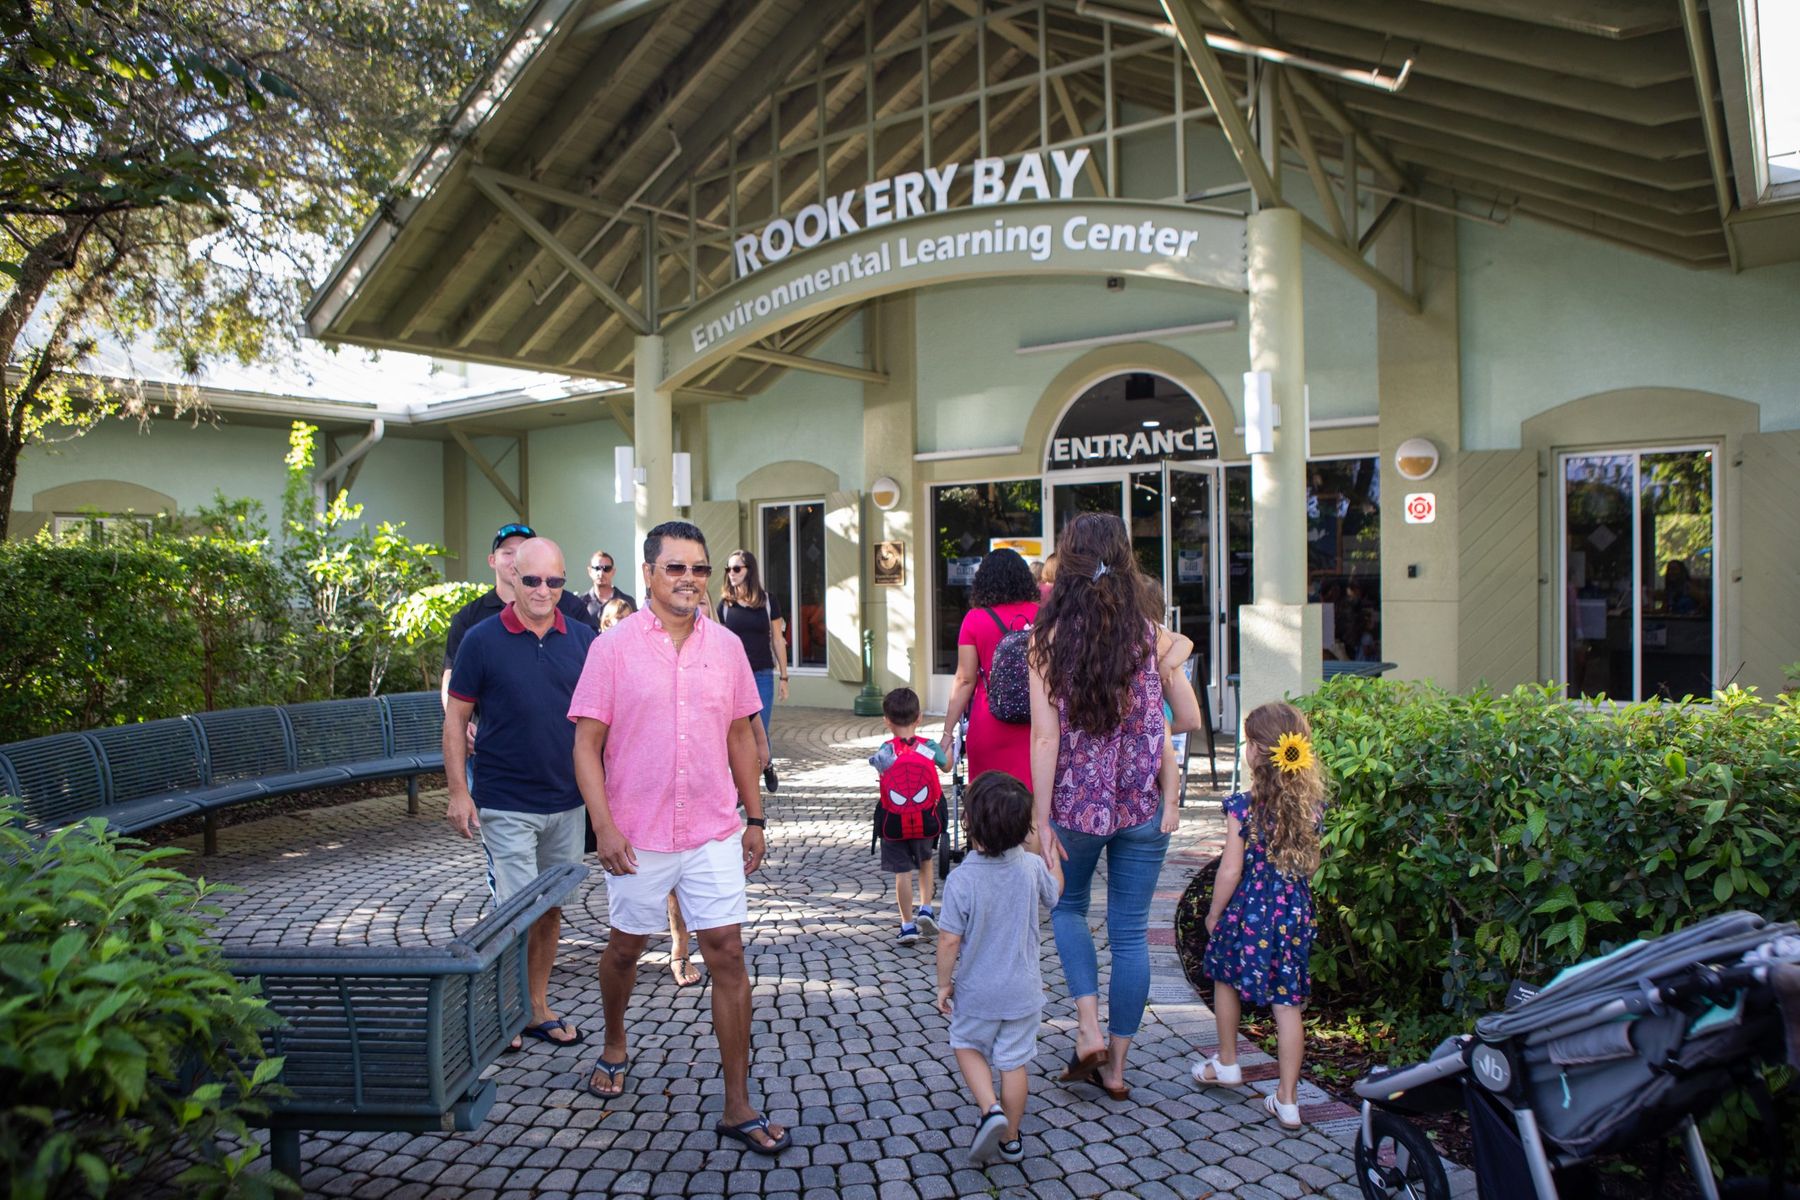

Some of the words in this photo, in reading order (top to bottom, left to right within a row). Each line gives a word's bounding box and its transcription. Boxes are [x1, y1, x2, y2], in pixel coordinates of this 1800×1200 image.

[733, 163, 958, 277] ROOKERY
[972, 148, 1090, 205] BAY
[691, 243, 892, 352] Environmental
[900, 220, 1052, 266] Learning
[1063, 217, 1198, 257] Center
[1054, 426, 1215, 461] ENTRANCE
